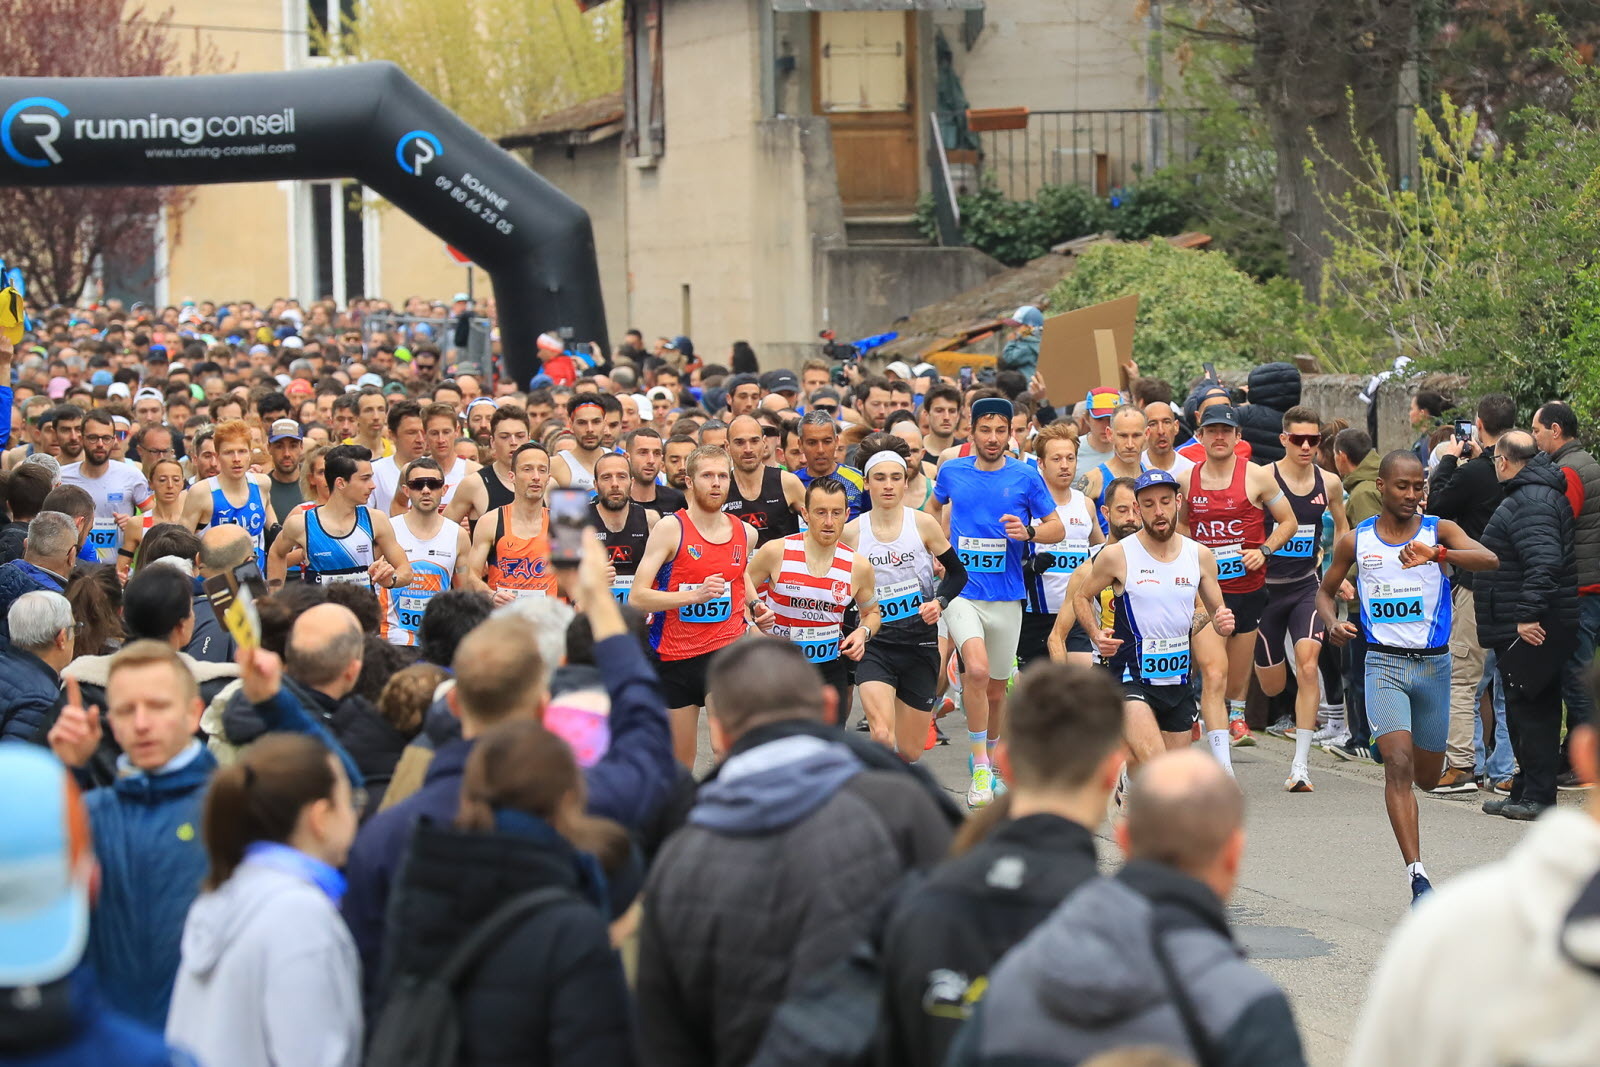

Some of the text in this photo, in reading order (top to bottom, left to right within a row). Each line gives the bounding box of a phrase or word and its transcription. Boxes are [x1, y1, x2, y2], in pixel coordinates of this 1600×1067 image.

[74, 108, 295, 145] running conseil
[144, 143, 296, 159] www.running-conseil.com
[460, 172, 509, 212] ROANNE
[435, 175, 514, 236] 09 80 66 25 05
[1195, 519, 1244, 538] ARC
[499, 557, 547, 579] FAC
[960, 553, 1005, 568] 3157
[682, 601, 730, 617] 3057
[790, 597, 837, 613] ROCKET
[879, 595, 921, 619] 3014
[1371, 600, 1422, 618] 3004
[801, 611, 825, 621] SODA
[804, 642, 838, 659] 007
[1144, 654, 1188, 673] 3002
